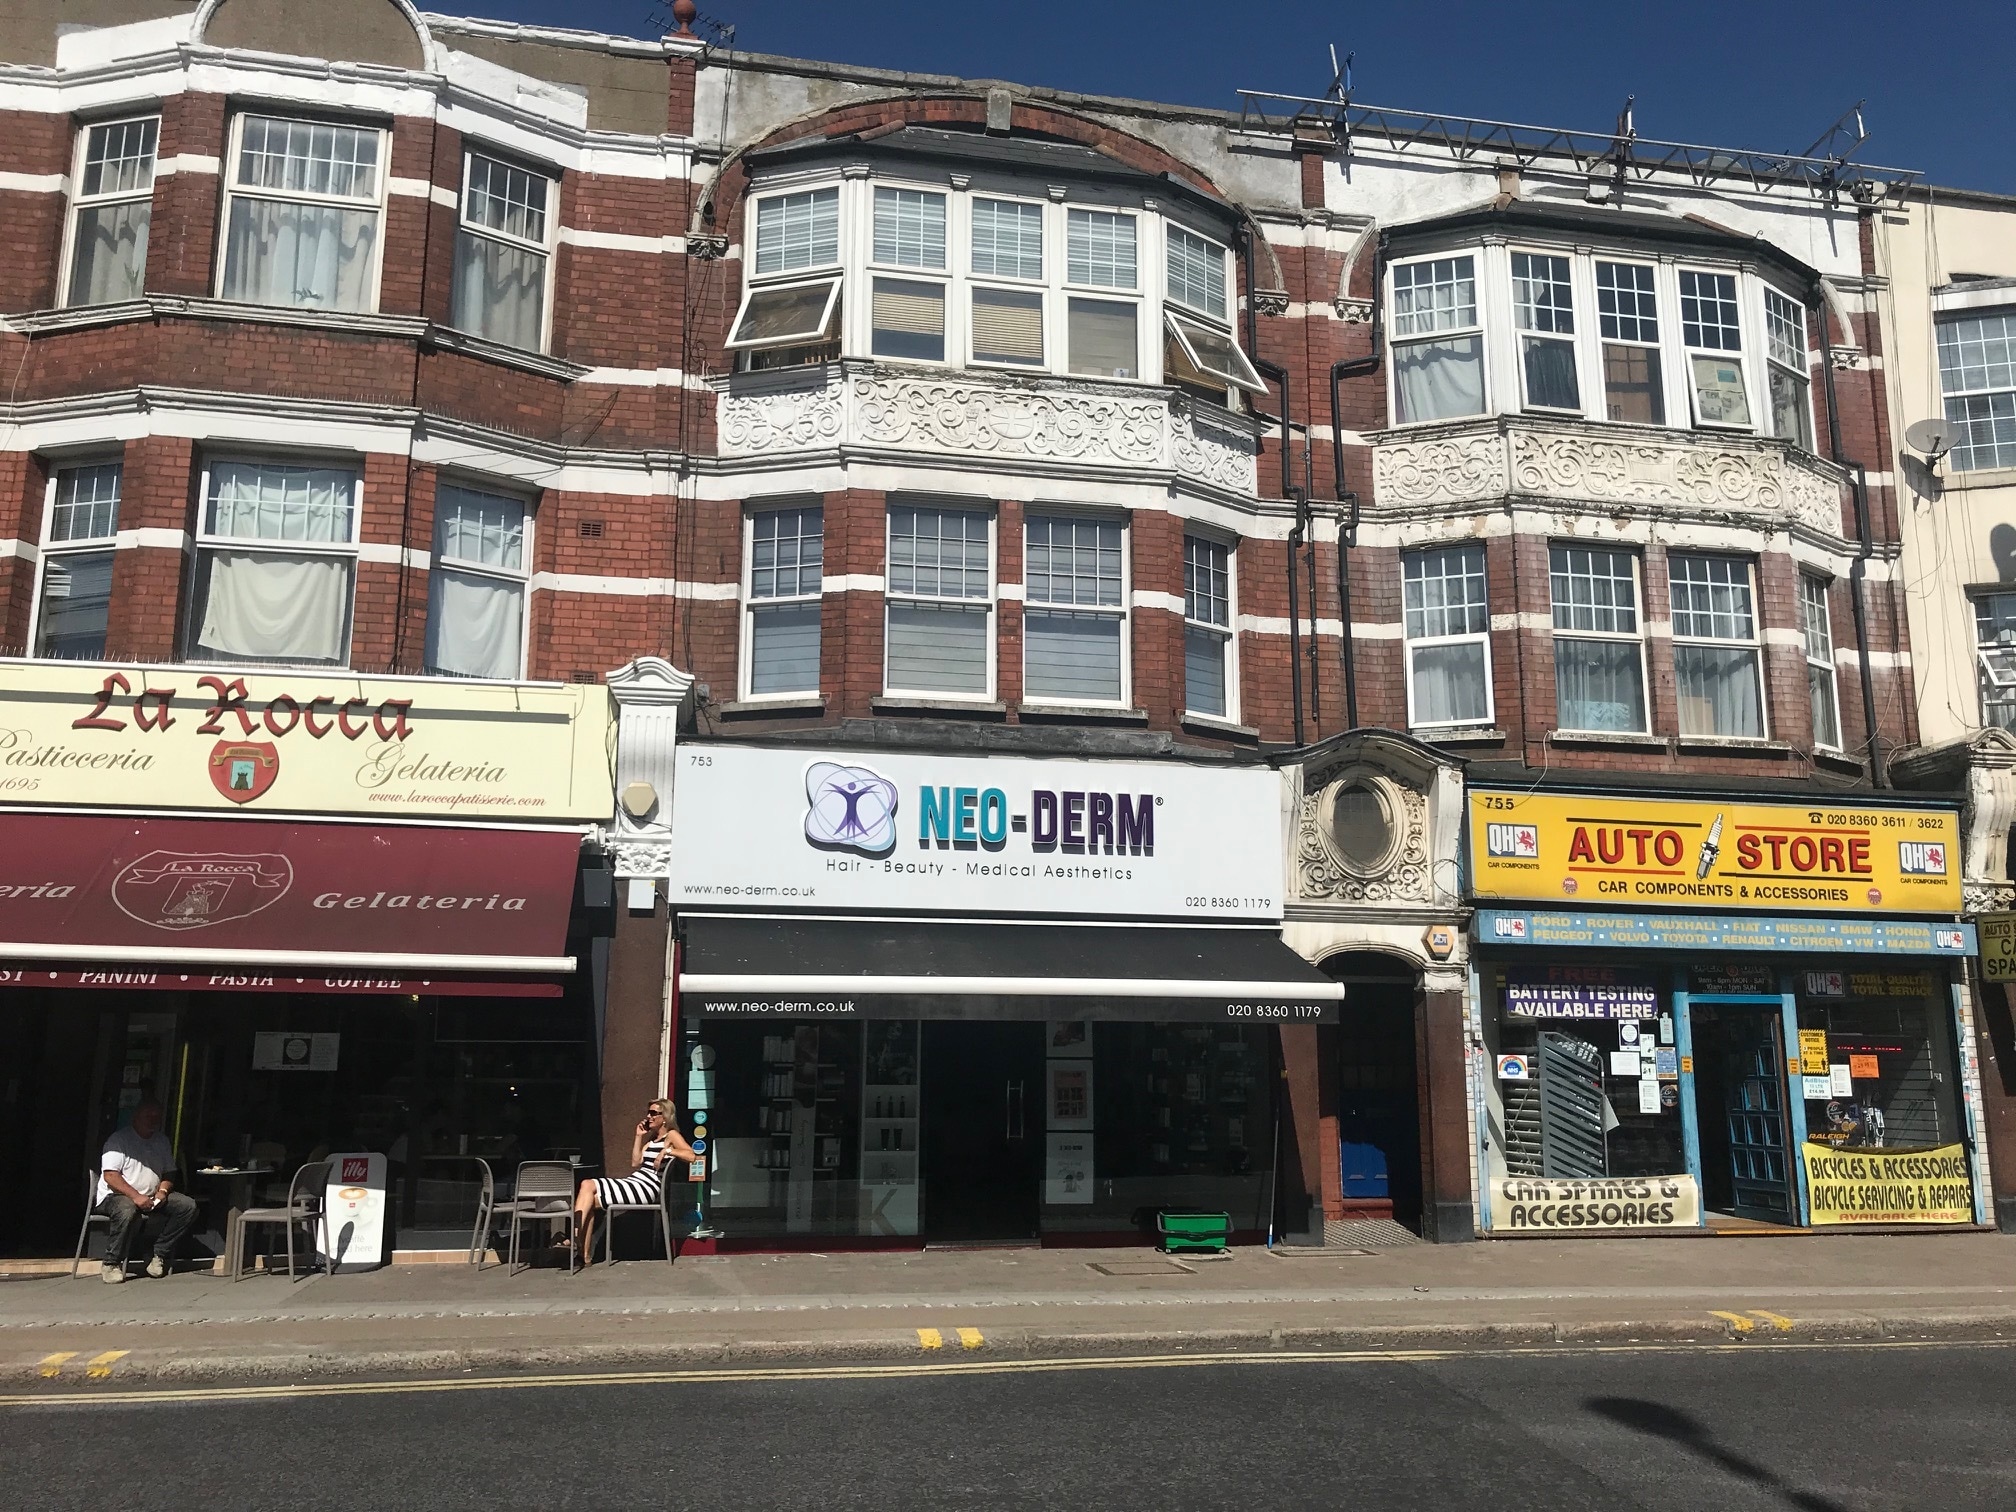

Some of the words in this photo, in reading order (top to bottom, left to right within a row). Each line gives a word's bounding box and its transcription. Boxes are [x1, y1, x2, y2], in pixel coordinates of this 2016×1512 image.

[72, 672, 176, 733] La
[196, 676, 413, 742] Rocca
[355, 740, 507, 788] Gelateria
[691, 756, 713, 766] 753
[368, 790, 546, 810] www.laroccapatisserie.com
[1485, 797, 1515, 810] 755
[1827, 814, 1847, 825] 020
[1850, 815, 1878, 826] 8360
[1882, 817, 1906, 828] 3611
[1917, 818, 1943, 829] 3622
[1488, 824, 1514, 855] QH
[1568, 827, 1684, 866] AUTO
[1737, 834, 1872, 873] STORE
[1900, 842, 1924, 872] QH
[826, 859, 862, 872] Hair
[884, 861, 943, 876] Beauty
[967, 863, 1035, 876] Medical
[1044, 865, 1132, 879] Aesthetics
[1501, 862, 1540, 870] COMPONENTS
[684, 885, 816, 897] www.neo-derm.co.uk
[1598, 880, 1628, 893] CAR
[1636, 881, 1733, 897] COMPONENTS
[1740, 886, 1749, 898] &
[1754, 886, 1849, 901] ACCESSORIES
[1912, 878, 1948, 886] COMPONENTS
[313, 892, 527, 911] Gelateria
[1185, 897, 1207, 907] 020
[1211, 898, 1239, 908] 8360
[1244, 899, 1271, 909] 1179
[1496, 918, 1511, 936] QH
[1532, 916, 1571, 927] FORD
[1587, 918, 1634, 929] ROVER
[1649, 920, 1719, 931] VAUXHALL
[1733, 922, 1760, 932] FIAT
[1776, 923, 1826, 934] NISSAN
[1840, 925, 1872, 935] BMW
[1885, 926, 1931, 937] HONDA
[1985, 924, 2010, 936] AUTO
[1533, 929, 1594, 940] PEUGEOT
[1610, 931, 1650, 942] VOLVO
[1662, 932, 1709, 944] TOYOTA
[1722, 934, 1776, 946] RENAULT
[1790, 936, 1843, 947] CITROEN
[1854, 938, 1874, 948] VW
[1887, 939, 1932, 949] MAZDA
[1937, 930, 1952, 947] QH
[79, 967, 159, 984] PANINI
[208, 969, 275, 986] PASTA
[1548, 967, 1616, 982] FREE
[1850, 974, 1883, 984] TOTAL
[1509, 983, 1581, 1000] BATTERY
[1585, 985, 1655, 1002] TESTING
[1853, 986, 1886, 995] TOTAL
[1888, 986, 1934, 997] SERVICE
[705, 1001, 855, 1012] www.neo-derm.co.uk
[1227, 1005, 1252, 1016] 020
[1256, 1006, 1288, 1017] 8360
[1294, 1006, 1321, 1017] 1179
[1512, 1002, 1604, 1018] AVAILABLE
[1609, 1003, 1653, 1018] HERE
[343, 1161, 367, 1180] illy
[1810, 1157, 1867, 1180] BICYCLES
[1868, 1157, 1882, 1180] &
[1883, 1157, 1969, 1180] ACCESSORIES
[1502, 1180, 1551, 1201] CAR
[1556, 1179, 1651, 1200] SPARES
[1658, 1177, 1680, 1198] &
[1814, 1184, 1856, 1210] BICYCLE
[1858, 1184, 1915, 1210] SERVICING
[1917, 1184, 1927, 1210] &
[1929, 1184, 1971, 1210] REPAIRS
[1511, 1202, 1674, 1227] ACCESSORIES
[1839, 1213, 1915, 1221] AVAILABLE
[1921, 1212, 1958, 1220] HERE
